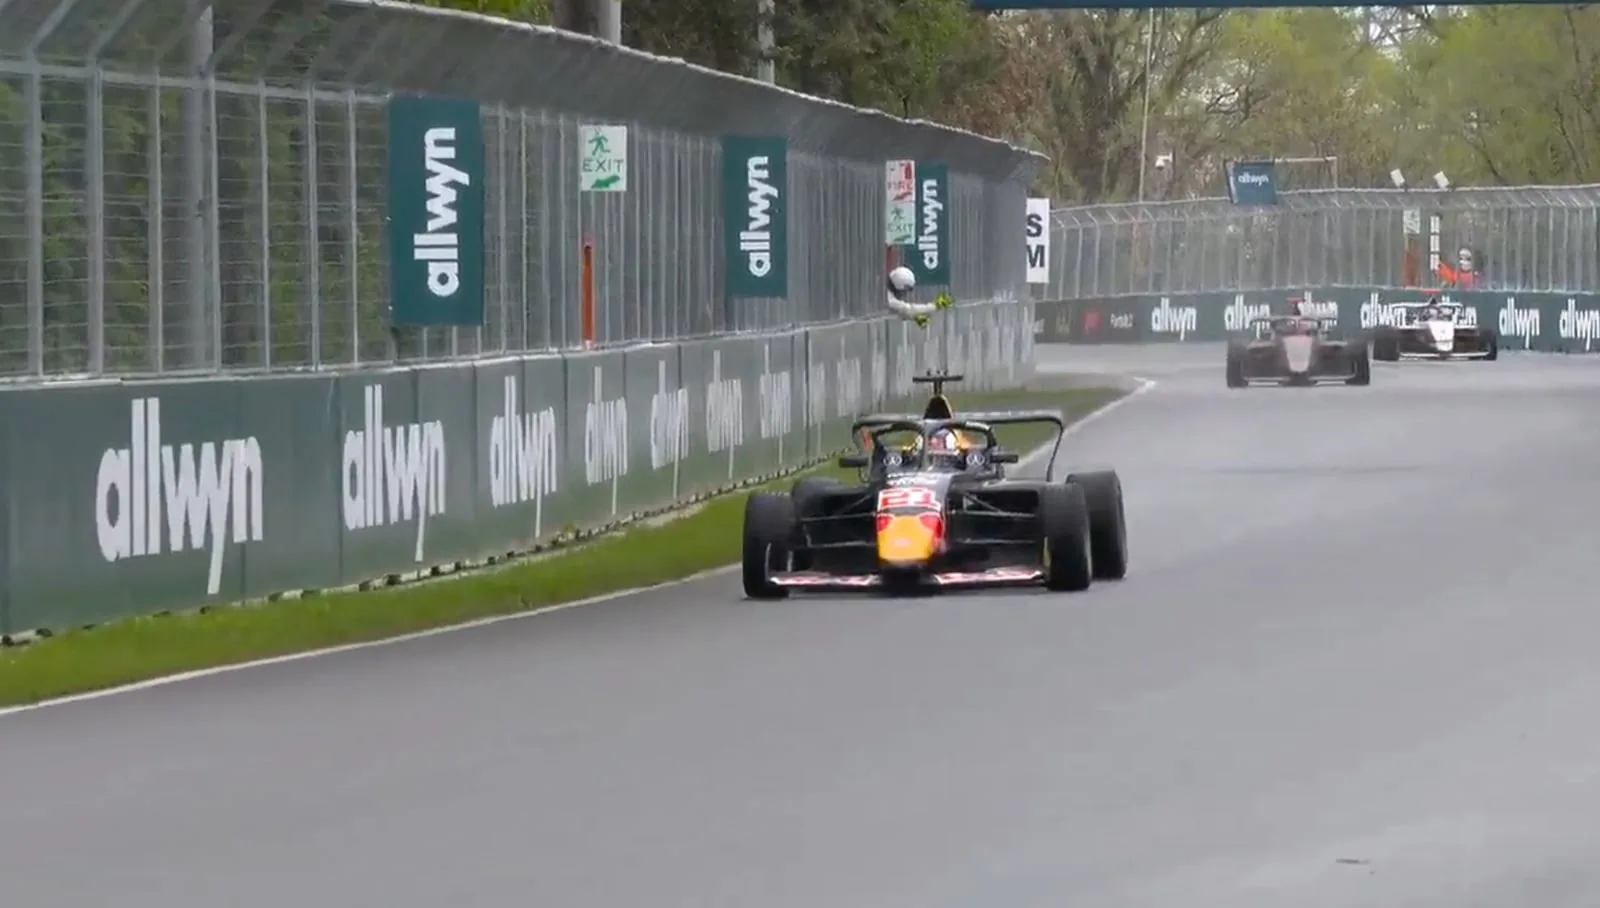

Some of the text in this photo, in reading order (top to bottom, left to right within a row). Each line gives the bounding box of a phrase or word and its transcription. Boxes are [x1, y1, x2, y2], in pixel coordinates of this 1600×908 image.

[414, 127, 469, 297] allwyn
[582, 158, 624, 173] EXIT
[740, 155, 779, 277] allwyn
[918, 179, 943, 269] allwyn
[1151, 297, 1197, 341] allwyn
[1499, 298, 1540, 349] allwyn
[1559, 299, 1600, 351] allwyn
[96, 397, 263, 595] allwyn
[342, 384, 446, 562] allwyn
[490, 375, 557, 538] allwyn
